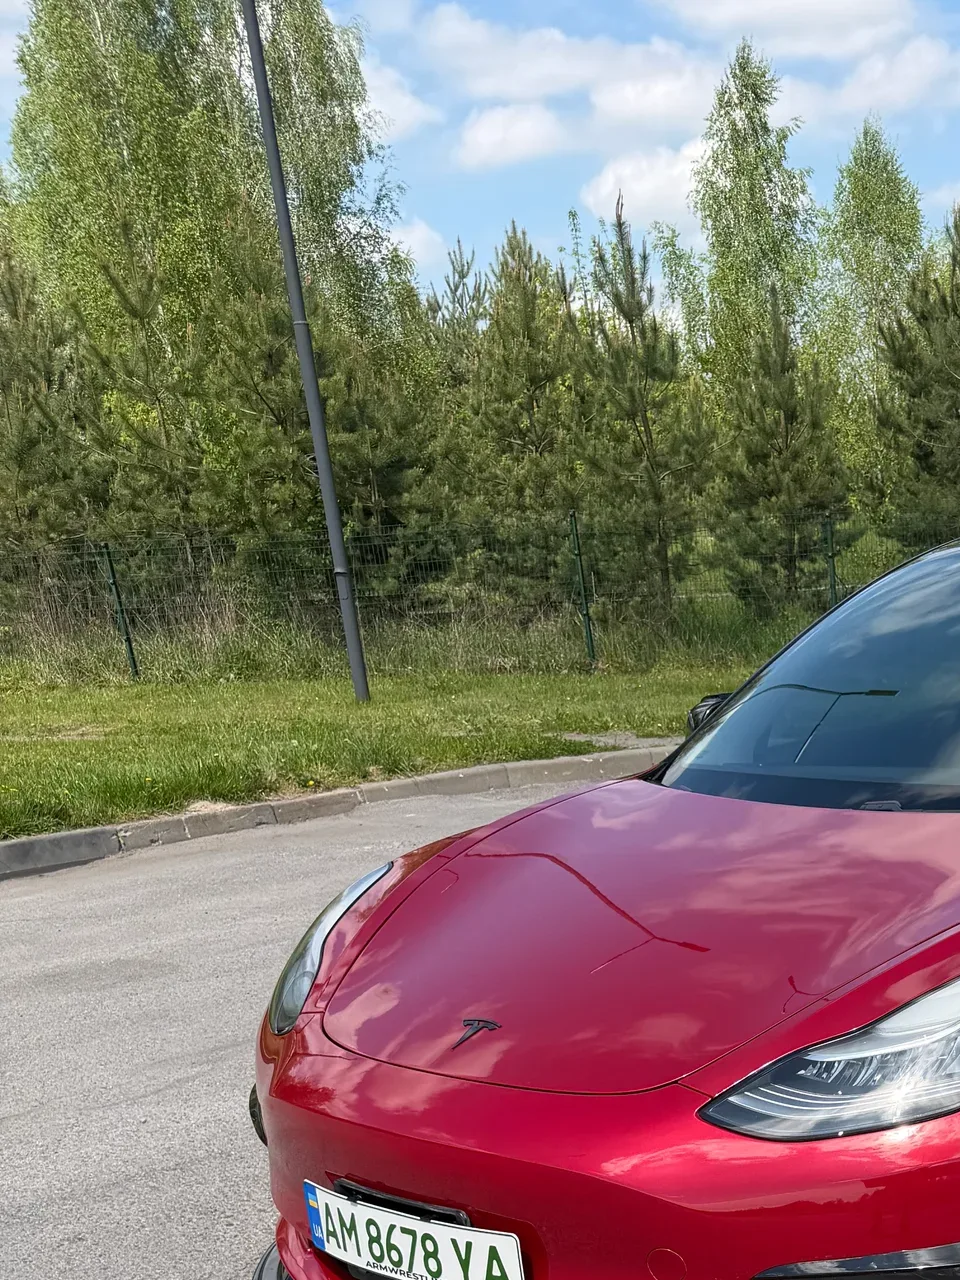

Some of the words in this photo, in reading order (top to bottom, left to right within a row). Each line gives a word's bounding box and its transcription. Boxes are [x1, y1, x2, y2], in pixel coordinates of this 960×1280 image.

[312, 1223, 324, 1240] UA
[324, 1201, 362, 1258] AM
[365, 1218, 443, 1279] 8678
